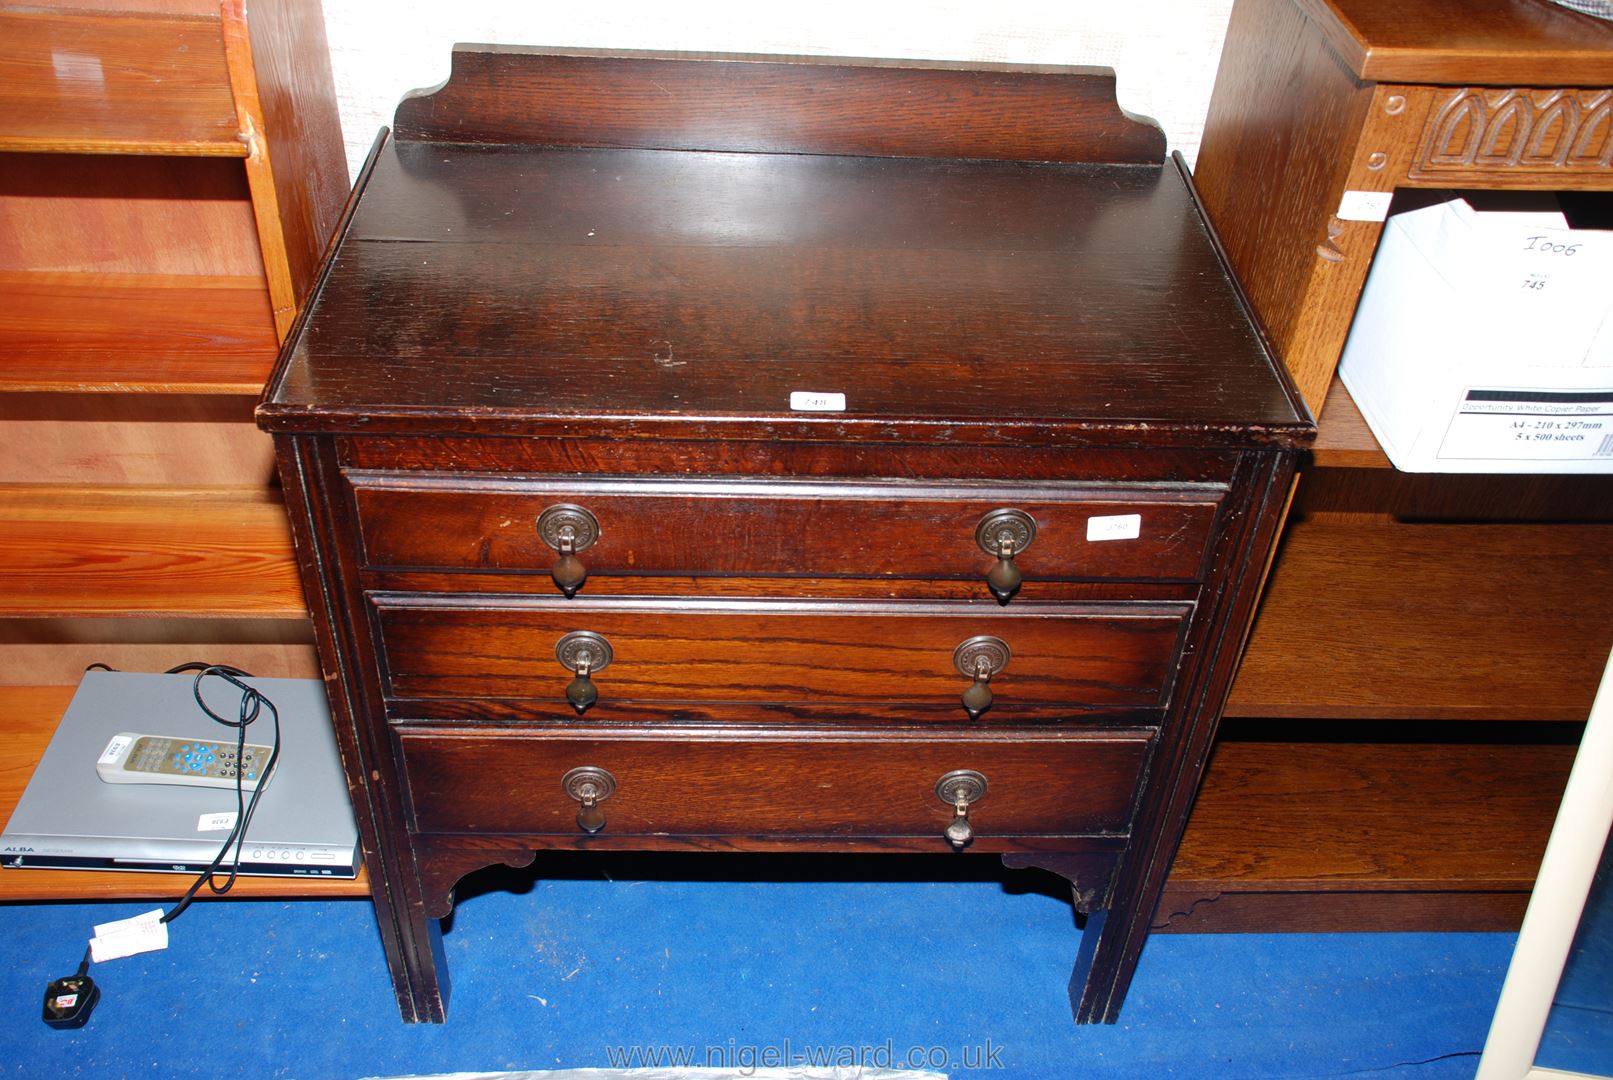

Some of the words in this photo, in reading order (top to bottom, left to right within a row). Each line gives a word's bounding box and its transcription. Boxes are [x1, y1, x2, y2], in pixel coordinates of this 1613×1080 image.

[1521, 280, 1546, 290] 745
[1462, 403, 1514, 411] Opportunity
[1545, 404, 1574, 413] Copier
[1575, 405, 1602, 413] Paper
[1510, 421, 1525, 429] A4
[1535, 421, 1553, 429] 210
[1564, 421, 1603, 429] 297mm
[1515, 432, 1523, 440] 5
[1533, 433, 1552, 441] 500
[1554, 433, 1585, 441] sheets
